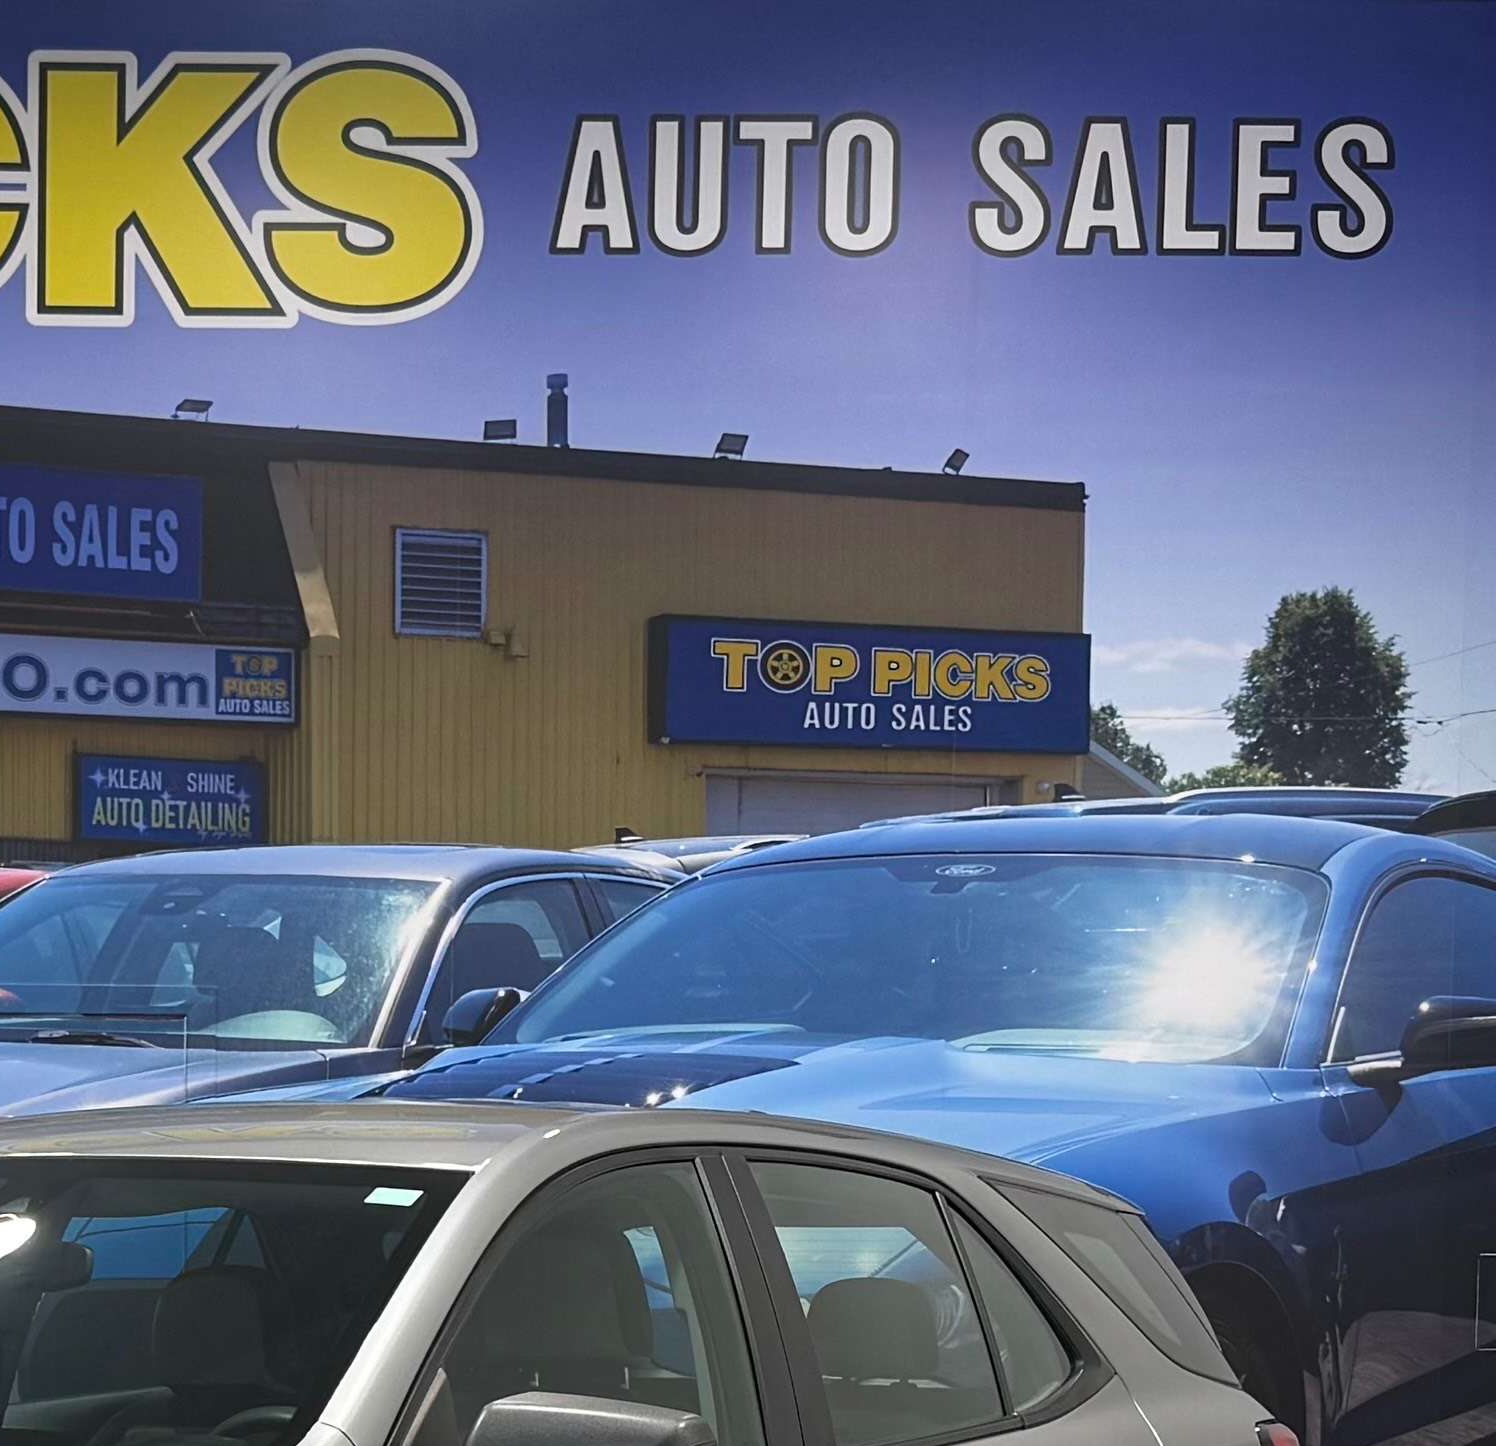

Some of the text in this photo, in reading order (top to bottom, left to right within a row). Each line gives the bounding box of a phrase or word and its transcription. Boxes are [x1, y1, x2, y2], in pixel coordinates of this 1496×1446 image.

[549, 110, 900, 258] AUTO
[969, 112, 1396, 260] SALES
[51, 500, 181, 575] SALES
[222, 653, 287, 699] TOP PICKS
[710, 637, 1051, 703] TOP PICKS
[218, 698, 290, 715] AUTO SALES
[804, 701, 972, 732] AUTO SALES
[108, 767, 235, 795] KLEAN SHINE
[92, 797, 251, 833] AUTO DETAILING
